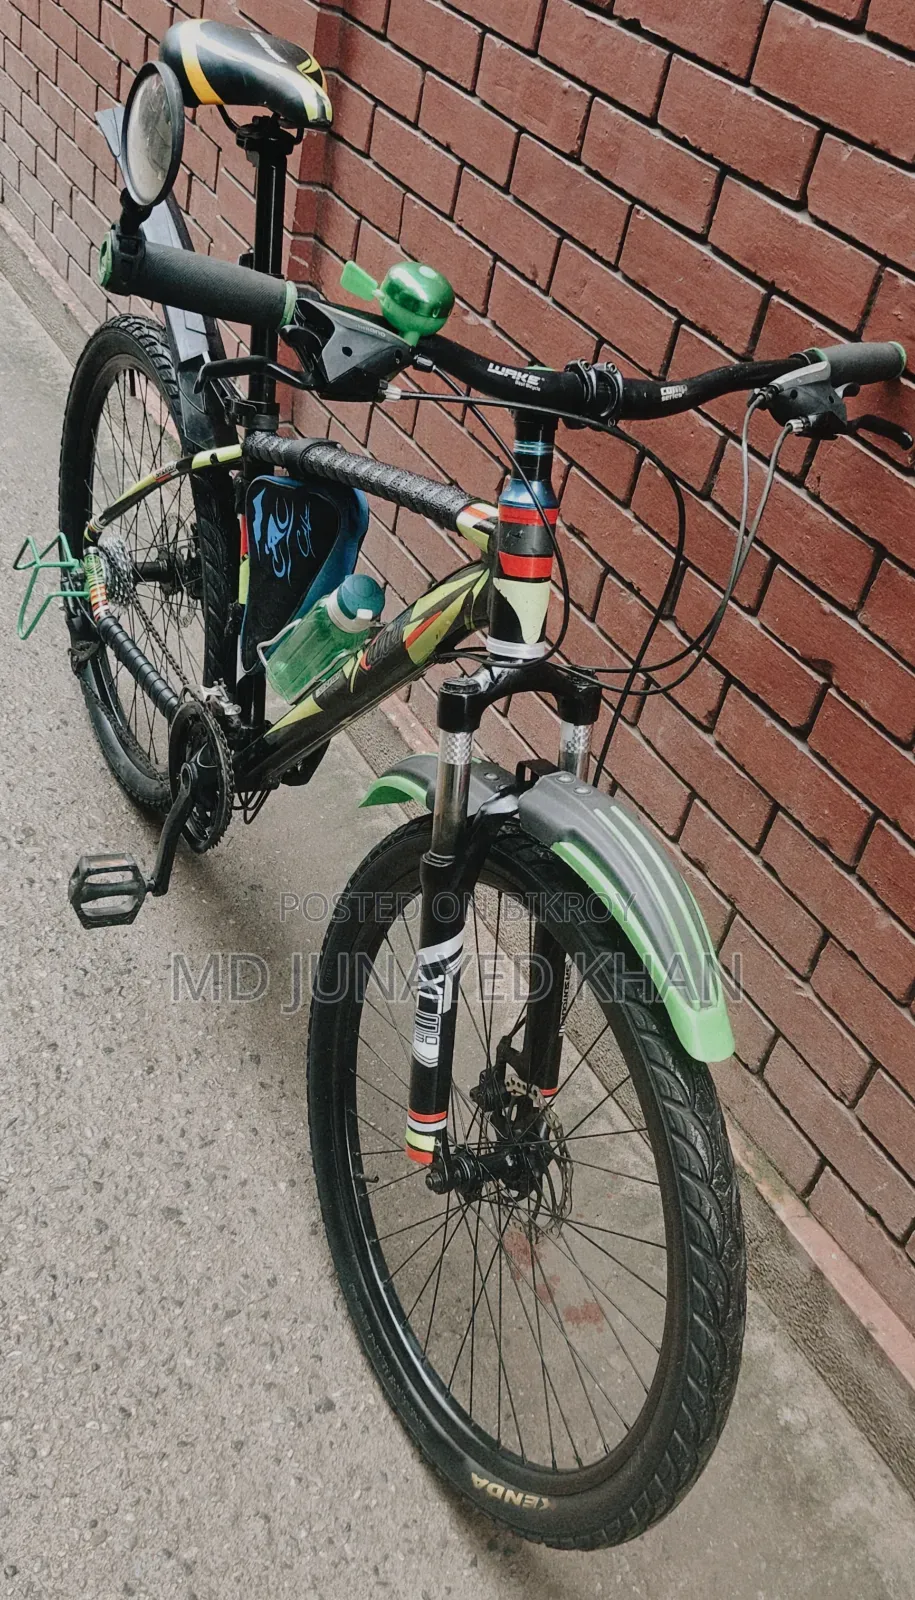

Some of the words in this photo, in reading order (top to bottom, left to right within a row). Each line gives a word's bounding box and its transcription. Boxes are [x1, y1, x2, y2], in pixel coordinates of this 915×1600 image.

[487, 362, 541, 386] WAKE
[660, 384, 687, 396] comp
[661, 392, 683, 402] series
[471, 1471, 556, 1512] KENDA
